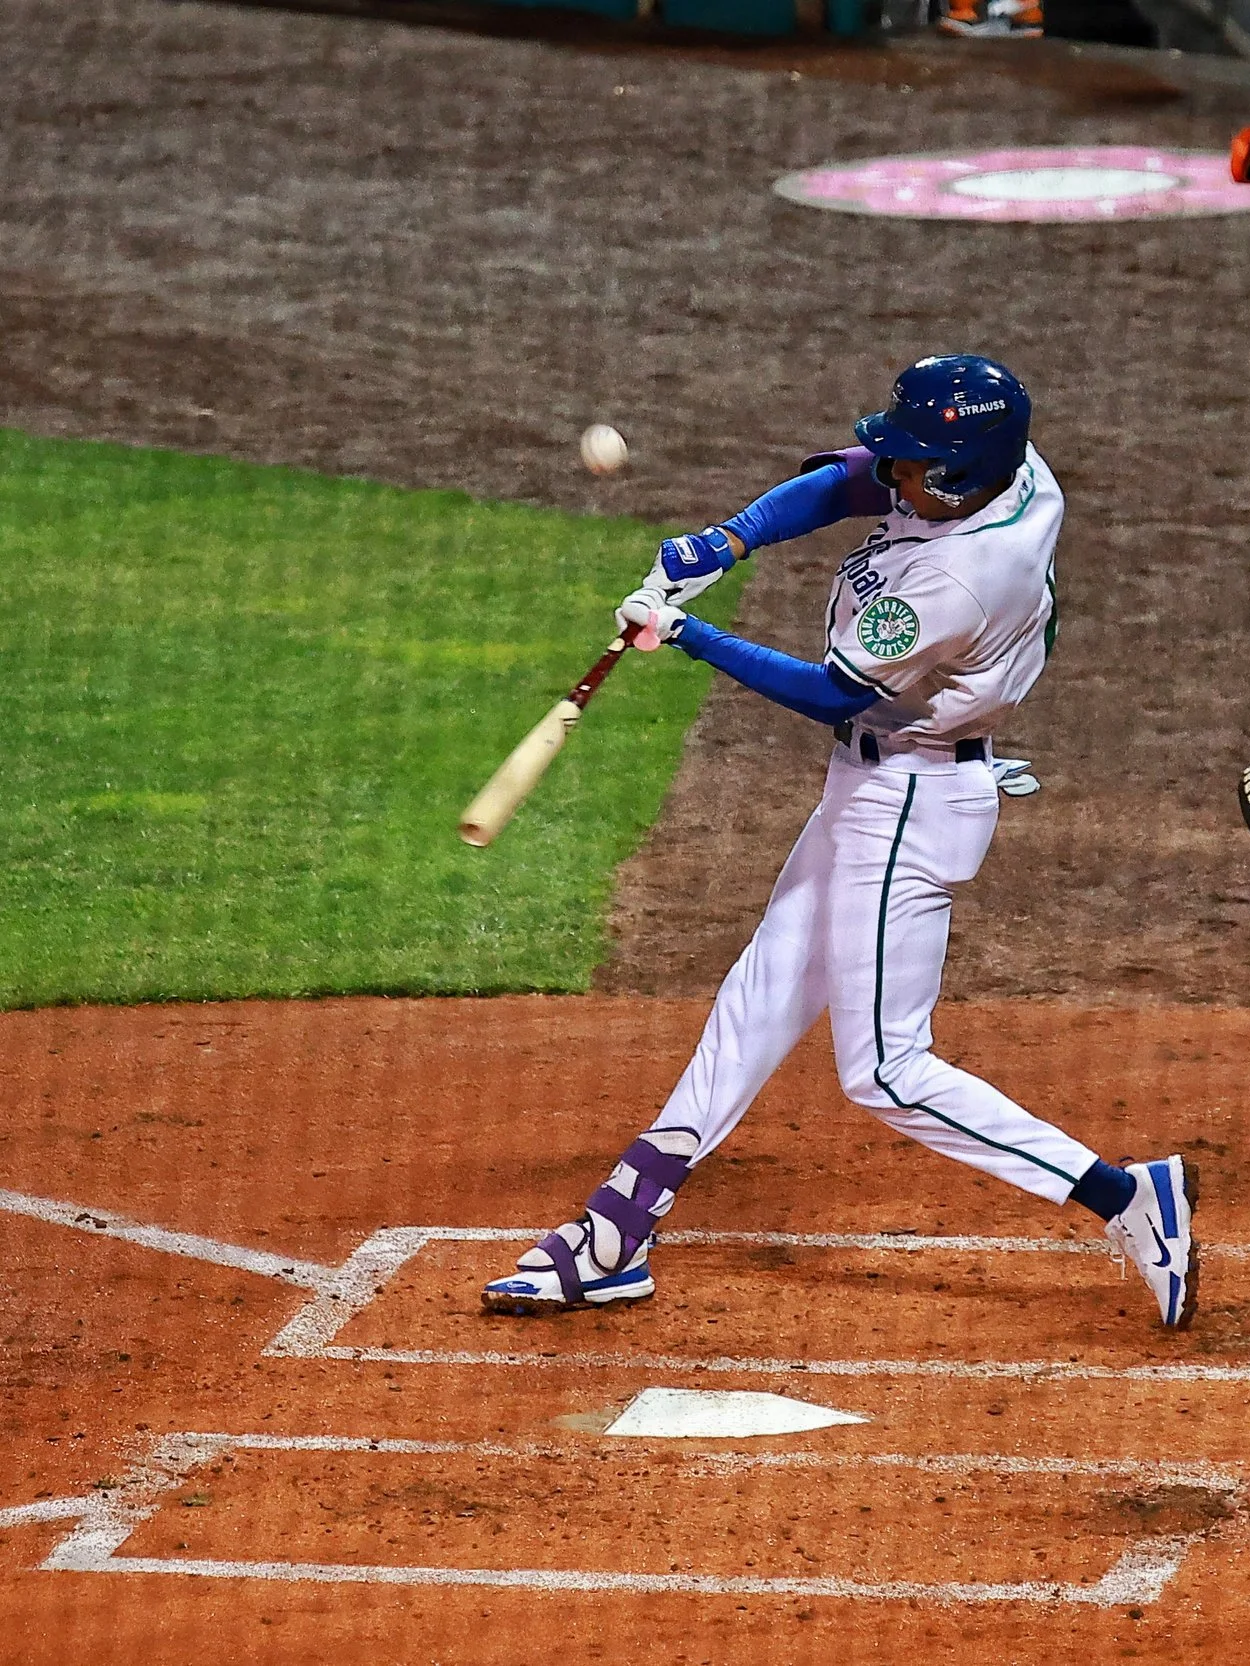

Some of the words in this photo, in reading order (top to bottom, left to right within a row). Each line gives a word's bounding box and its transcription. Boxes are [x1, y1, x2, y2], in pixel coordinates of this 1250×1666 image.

[958, 400, 1006, 417] STRAUSS
[876, 600, 916, 637] HARTFORD
[871, 640, 906, 656] GOATS
